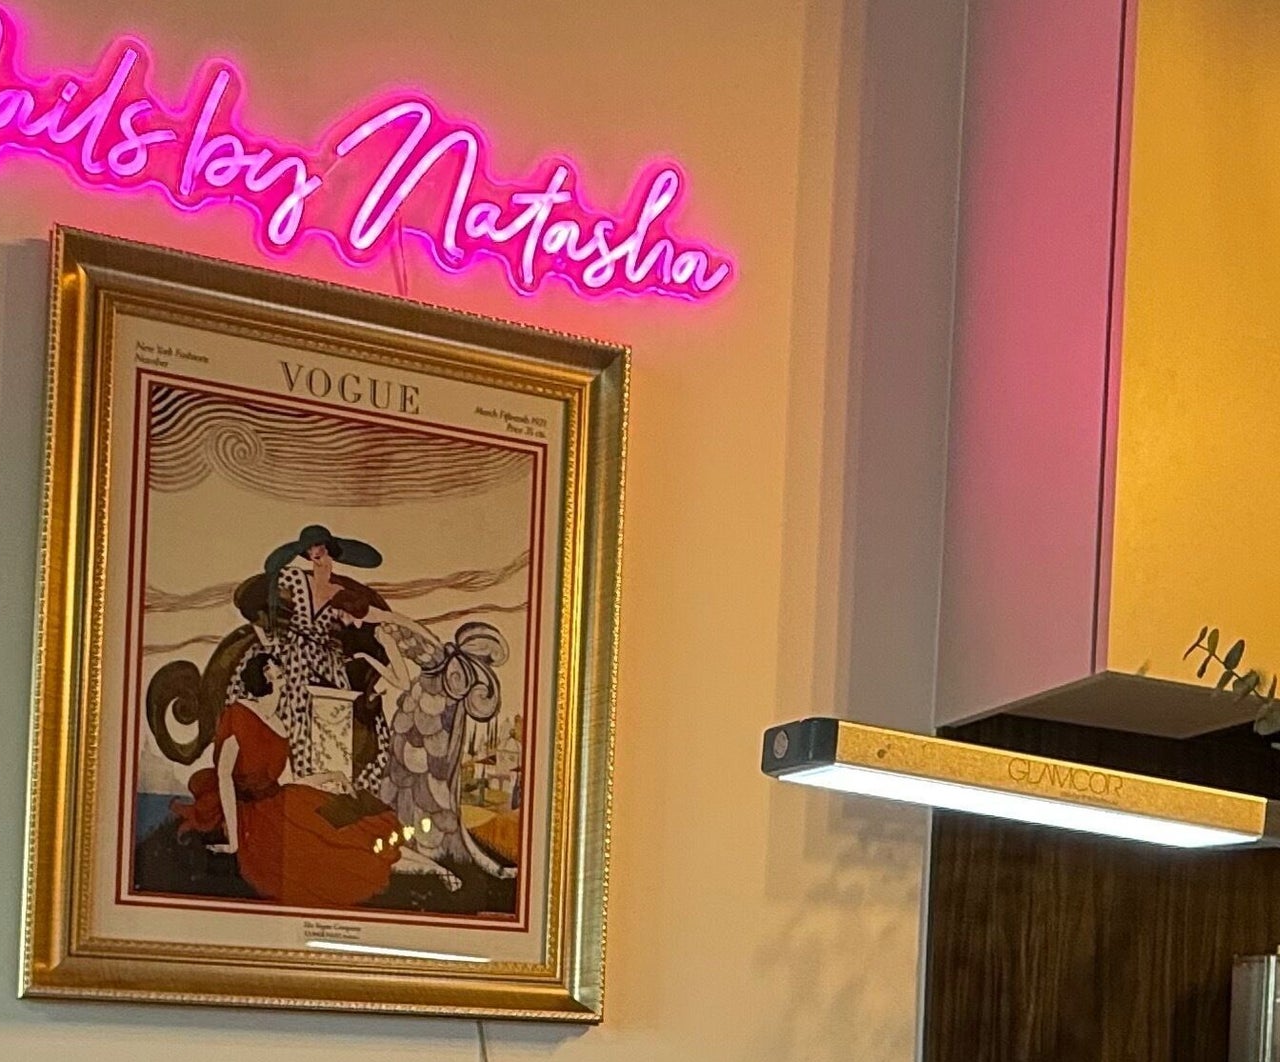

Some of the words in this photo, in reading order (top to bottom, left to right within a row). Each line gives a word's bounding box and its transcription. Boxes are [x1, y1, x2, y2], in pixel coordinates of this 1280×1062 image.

[179, 69, 322, 245] by
[337, 101, 729, 291] Natasha
[278, 360, 421, 416] VOGUE
[1008, 757, 1123, 798] GLAMCOR
